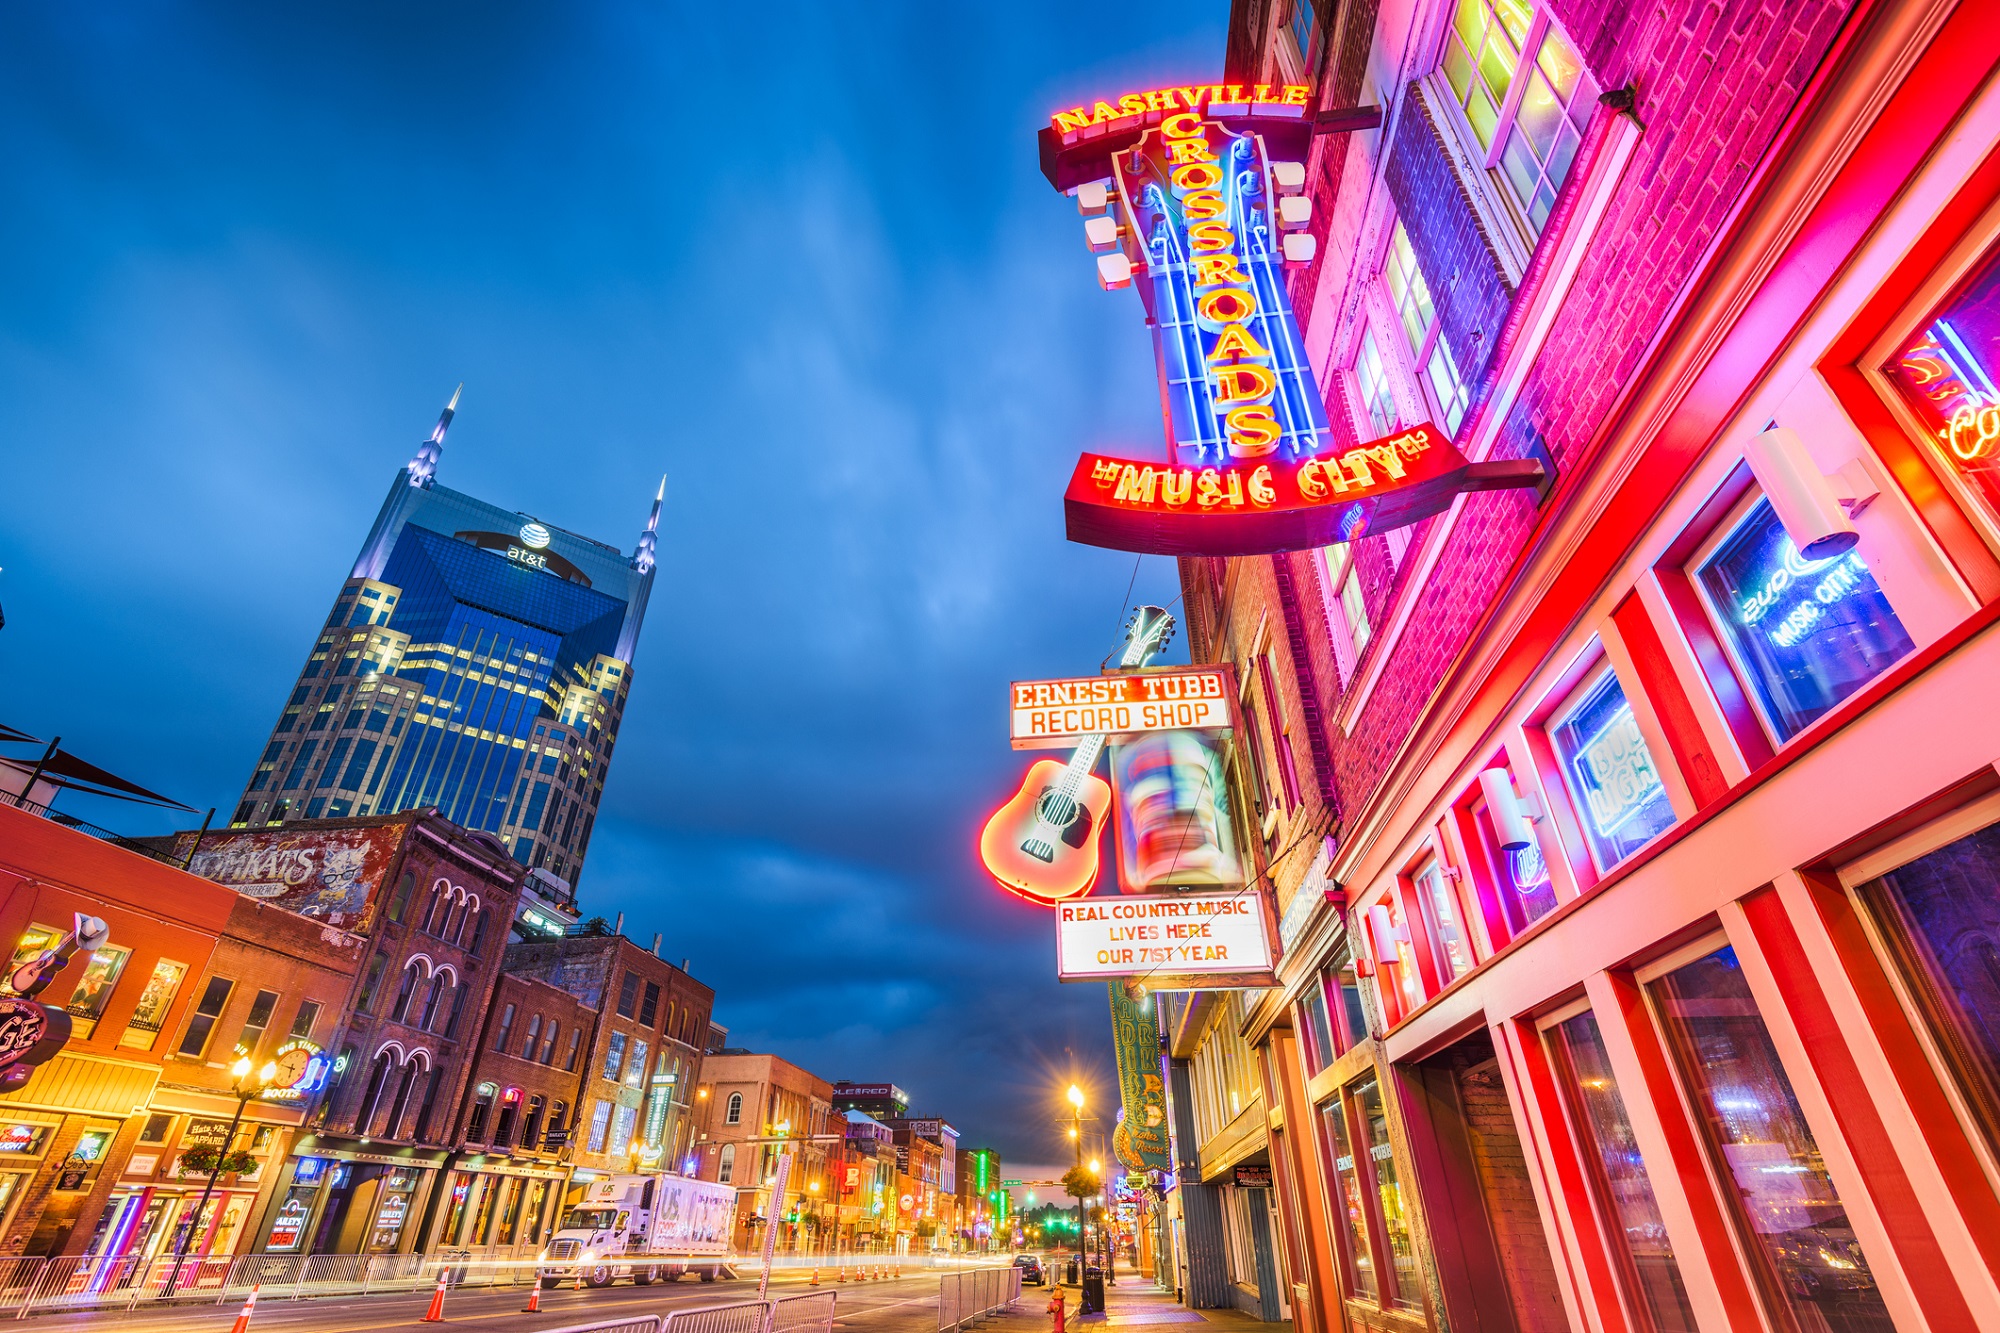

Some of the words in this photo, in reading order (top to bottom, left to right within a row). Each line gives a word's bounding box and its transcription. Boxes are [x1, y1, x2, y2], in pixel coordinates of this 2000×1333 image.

[1051, 84, 1310, 138] NASHVILLE
[1161, 112, 1282, 456] CROSSROADS
[507, 547, 546, 569] at&t
[1772, 600, 1819, 647] MUSIC
[1815, 563, 1853, 604] CITY
[1016, 680, 1127, 708] ERNEST
[1143, 675, 1221, 700] TUBB
[1031, 707, 1131, 734] RECORD
[1143, 703, 1209, 729] SHOP
[1591, 749, 1661, 825] LIGH
[195, 847, 317, 885] OMKATS
[1063, 904, 1109, 922] REAL
[1113, 902, 1194, 919] COUNTRY
[1197, 901, 1249, 916] MUSIC
[1110, 925, 1159, 941] LIVES
[1167, 923, 1212, 939] HERE
[1097, 950, 1134, 964] OUR
[1139, 948, 1174, 962] 71ST
[1182, 946, 1229, 961] YEAR
[277, 1042, 296, 1056] BIG
[297, 1040, 320, 1056] TIME
[262, 1088, 302, 1098] BOOTS
[649, 1087, 667, 1147] WHISKEY
[1370, 1142, 1392, 1162] TUBB
